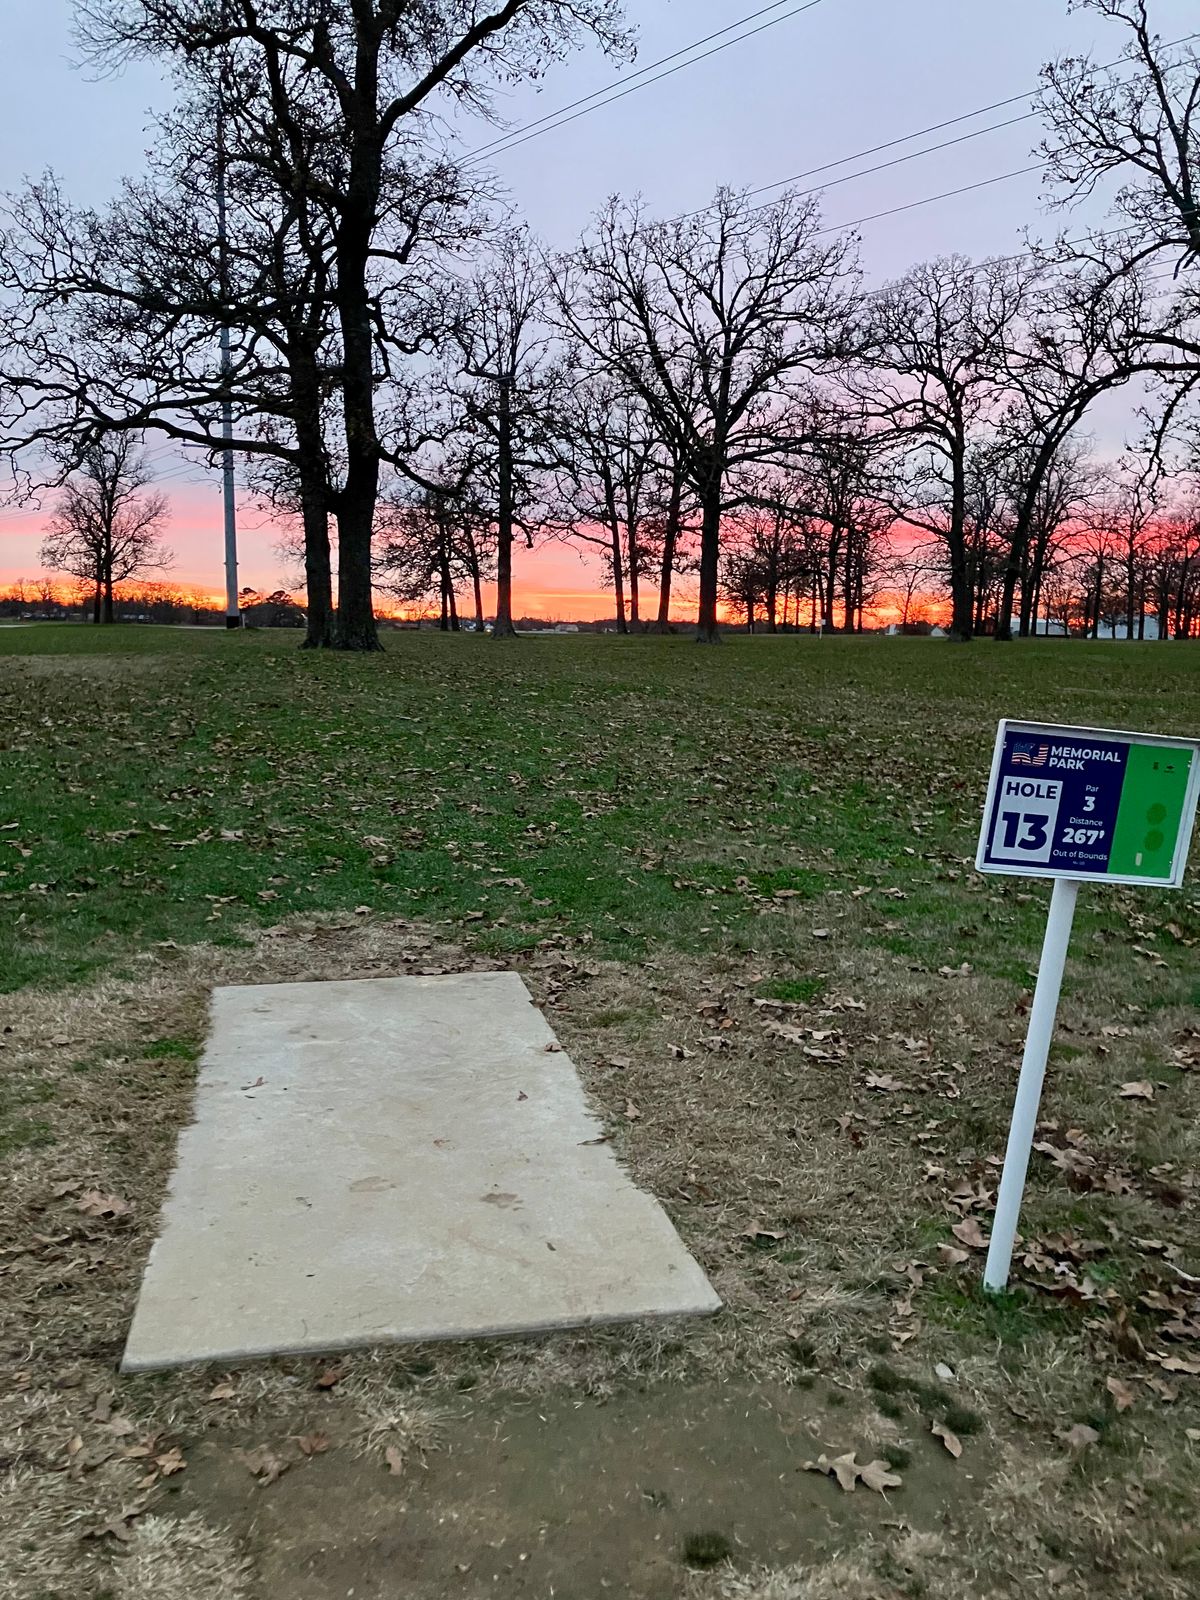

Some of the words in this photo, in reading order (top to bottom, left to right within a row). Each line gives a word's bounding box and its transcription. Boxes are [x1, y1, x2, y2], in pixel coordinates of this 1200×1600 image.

[1051, 746, 1121, 762] MEMORIAL
[1049, 757, 1084, 770] PARK
[1006, 782, 1058, 799] HOLE
[1086, 785, 1099, 793] Par
[1083, 796, 1095, 811] 3
[1070, 817, 1103, 826] Distance
[1003, 812, 1049, 850] 13
[1053, 849, 1067, 858] Out
[1079, 852, 1108, 861] Bounds
